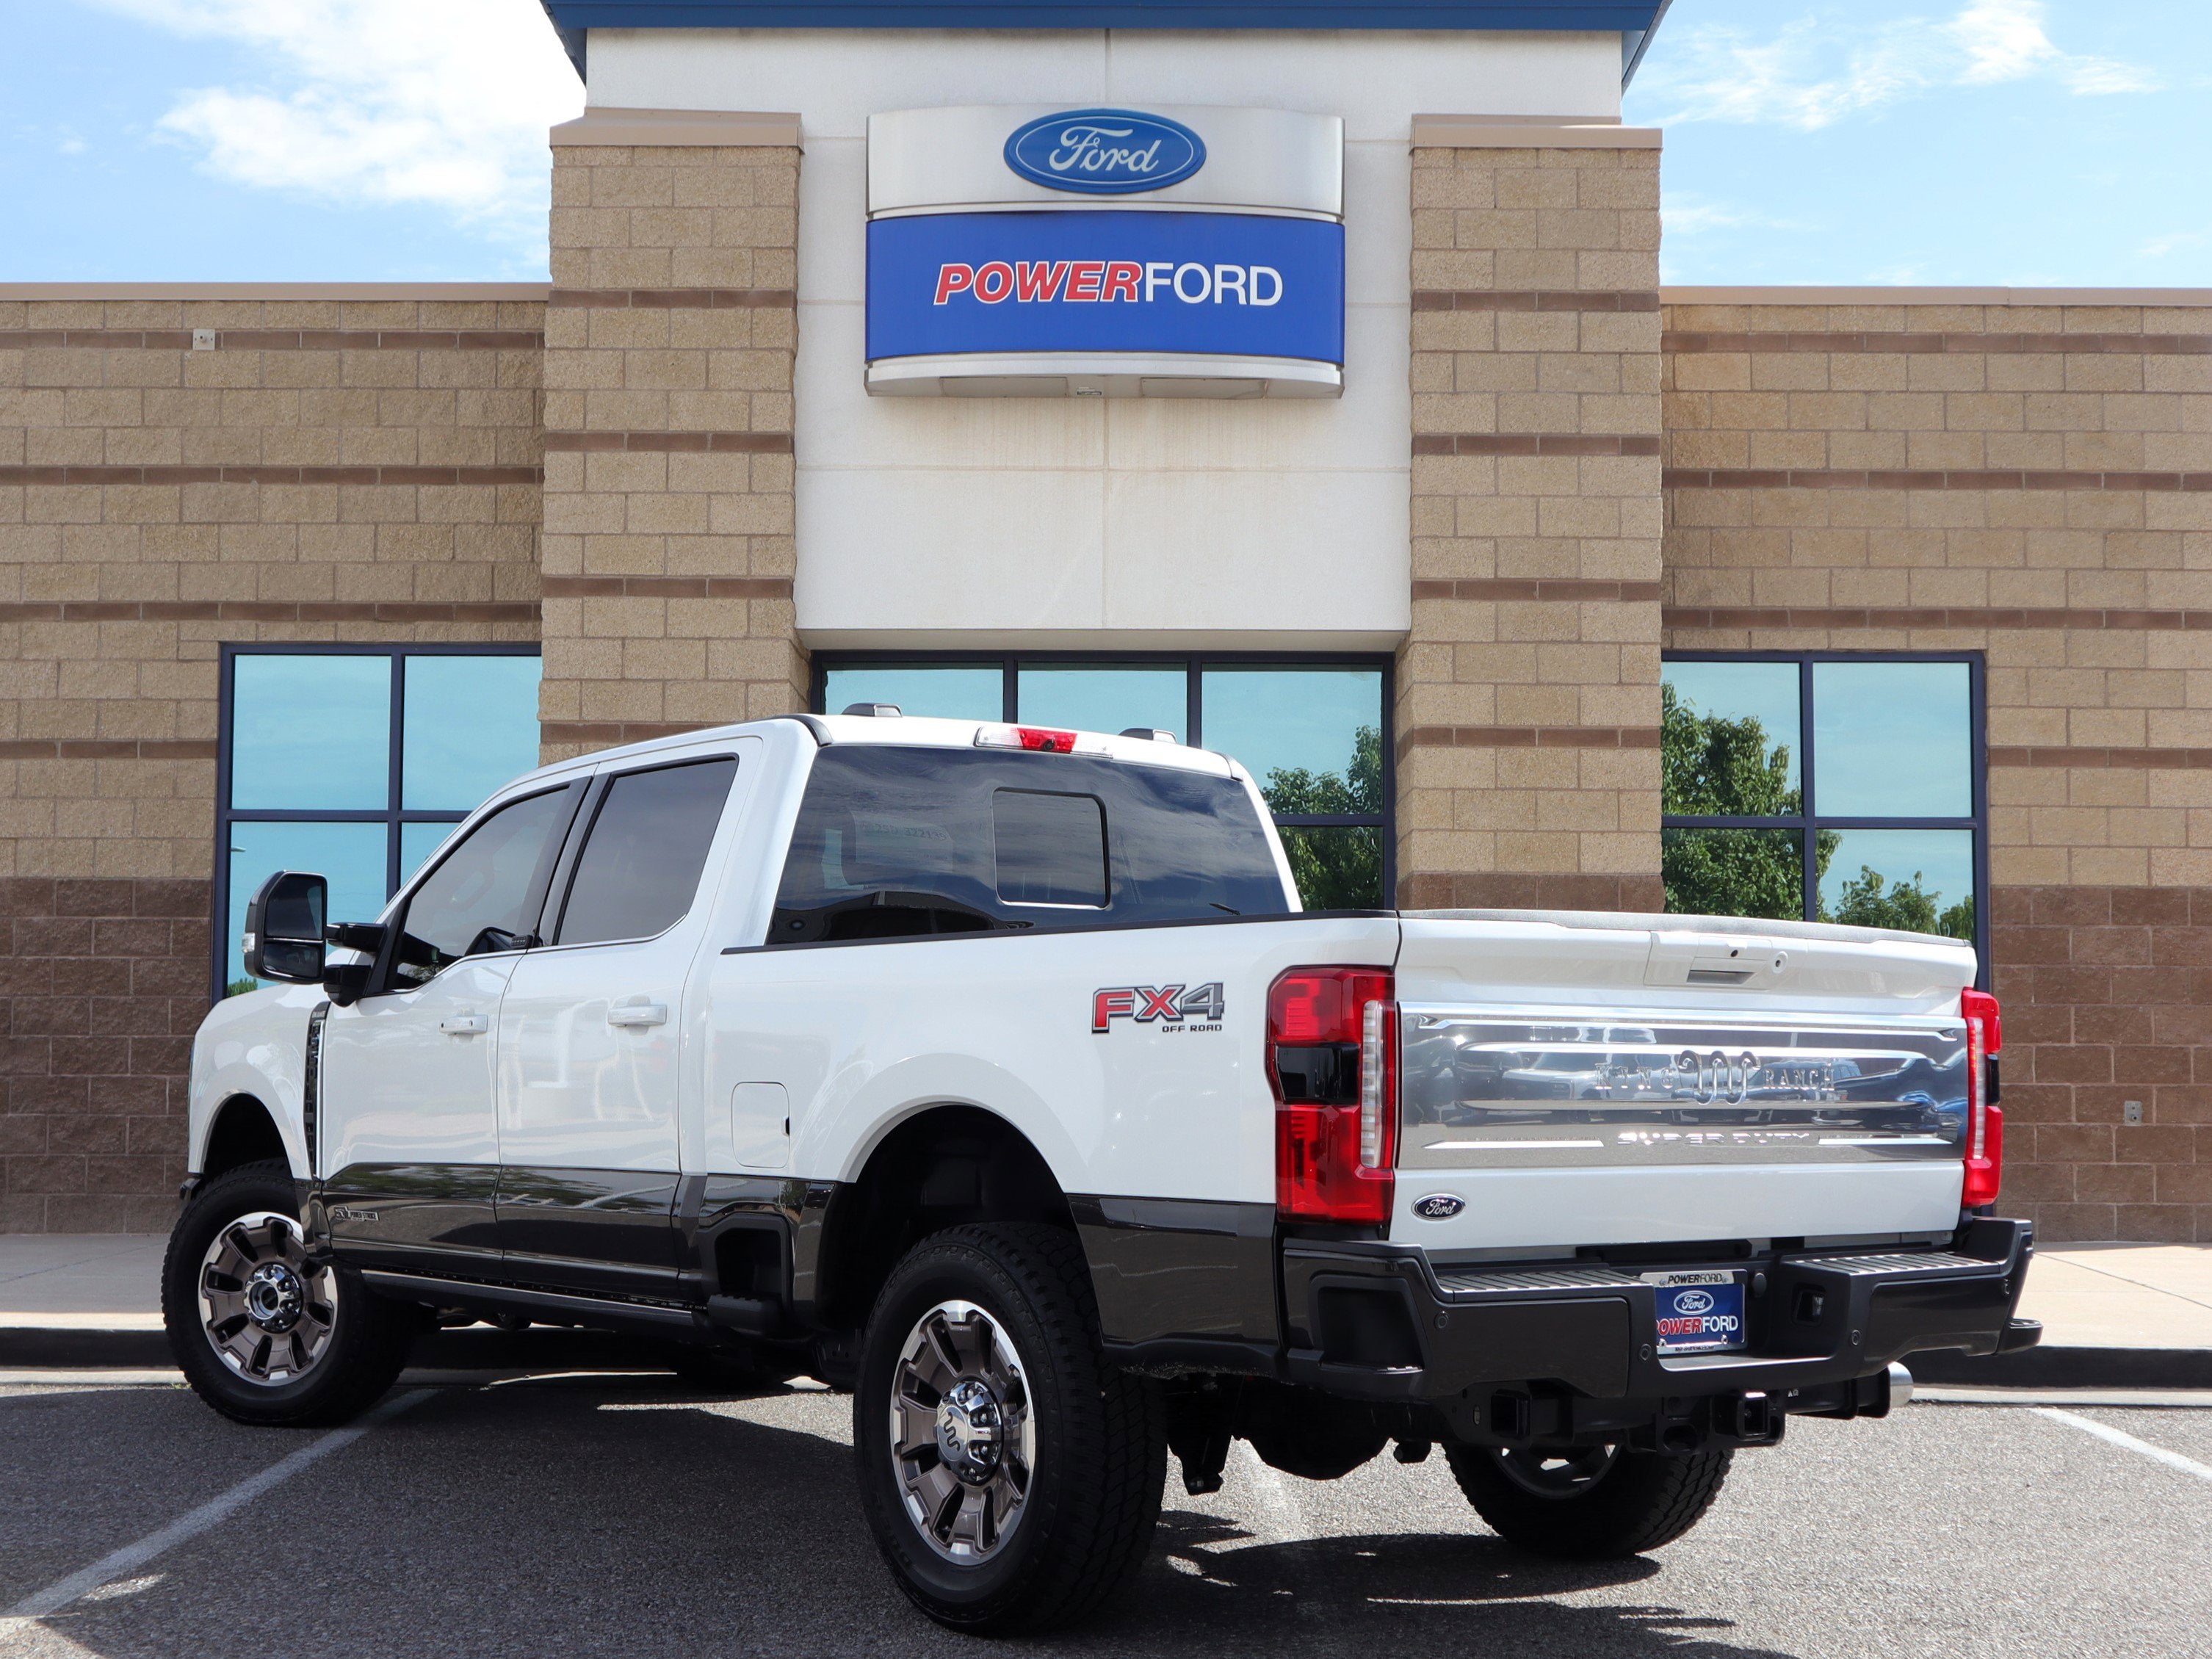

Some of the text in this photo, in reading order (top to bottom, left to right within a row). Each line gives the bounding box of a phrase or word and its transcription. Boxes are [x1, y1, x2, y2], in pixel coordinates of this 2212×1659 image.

[1049, 125, 1162, 173] Ford
[1091, 981, 1224, 1034] FX4
[1162, 1024, 1223, 1033] OFF ROAD
[1763, 1063, 1835, 1091] RANCH
[1425, 1199, 1458, 1215] Ford
[1681, 1294, 1706, 1310] Ford
